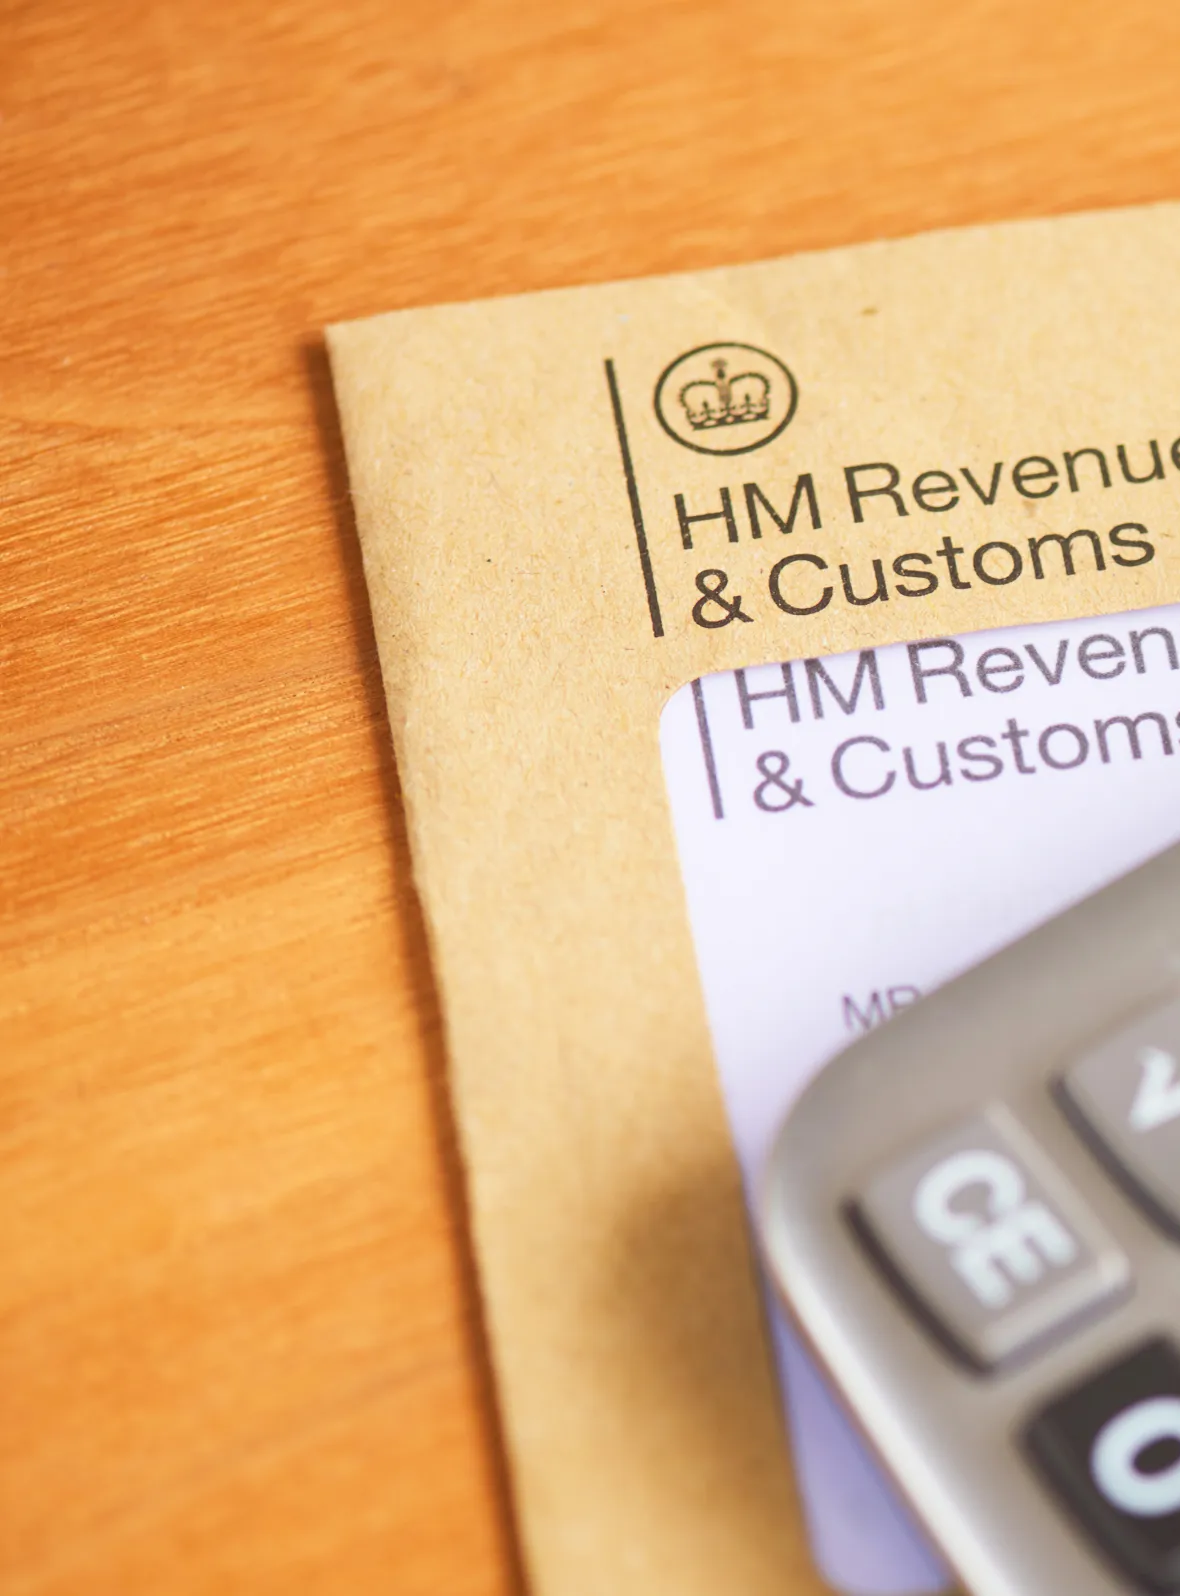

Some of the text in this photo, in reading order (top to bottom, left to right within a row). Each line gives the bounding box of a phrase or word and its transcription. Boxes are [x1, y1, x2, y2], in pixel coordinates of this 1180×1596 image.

[673, 473, 823, 550] HM
[691, 520, 1156, 631] & Customs
[733, 648, 886, 730] HM
[752, 749, 816, 813] &
[914, 1148, 1076, 1311] CE
